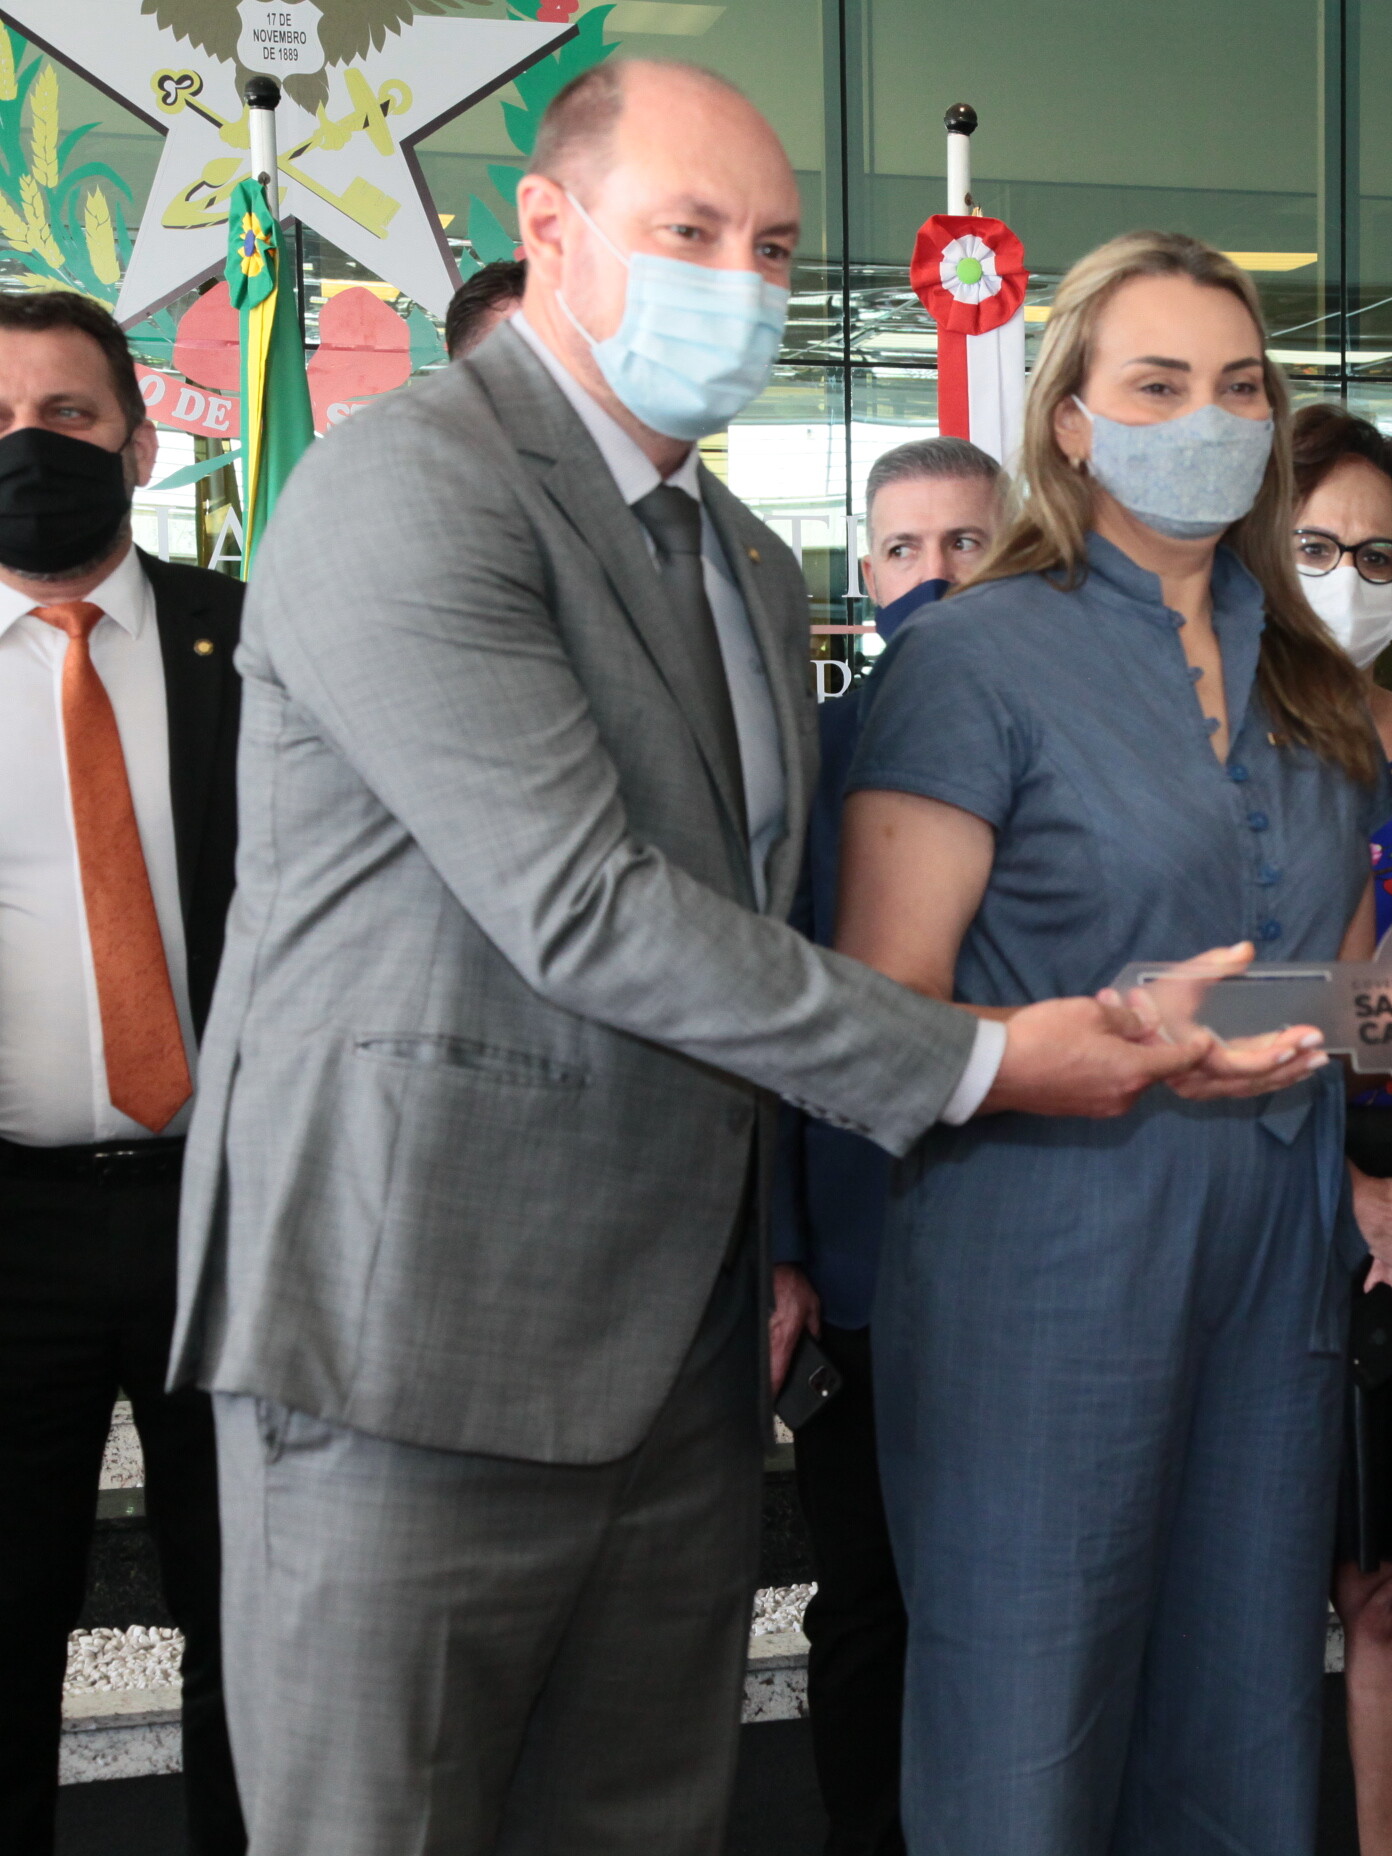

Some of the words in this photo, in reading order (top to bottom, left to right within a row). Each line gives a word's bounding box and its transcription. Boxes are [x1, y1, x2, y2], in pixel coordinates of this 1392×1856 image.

[266, 12, 277, 26] 17
[279, 13, 292, 27] DE
[253, 28, 307, 45] NOVEMBRO
[262, 46, 276, 60] DE
[278, 47, 299, 61] 1889
[171, 387, 232, 431] DE
